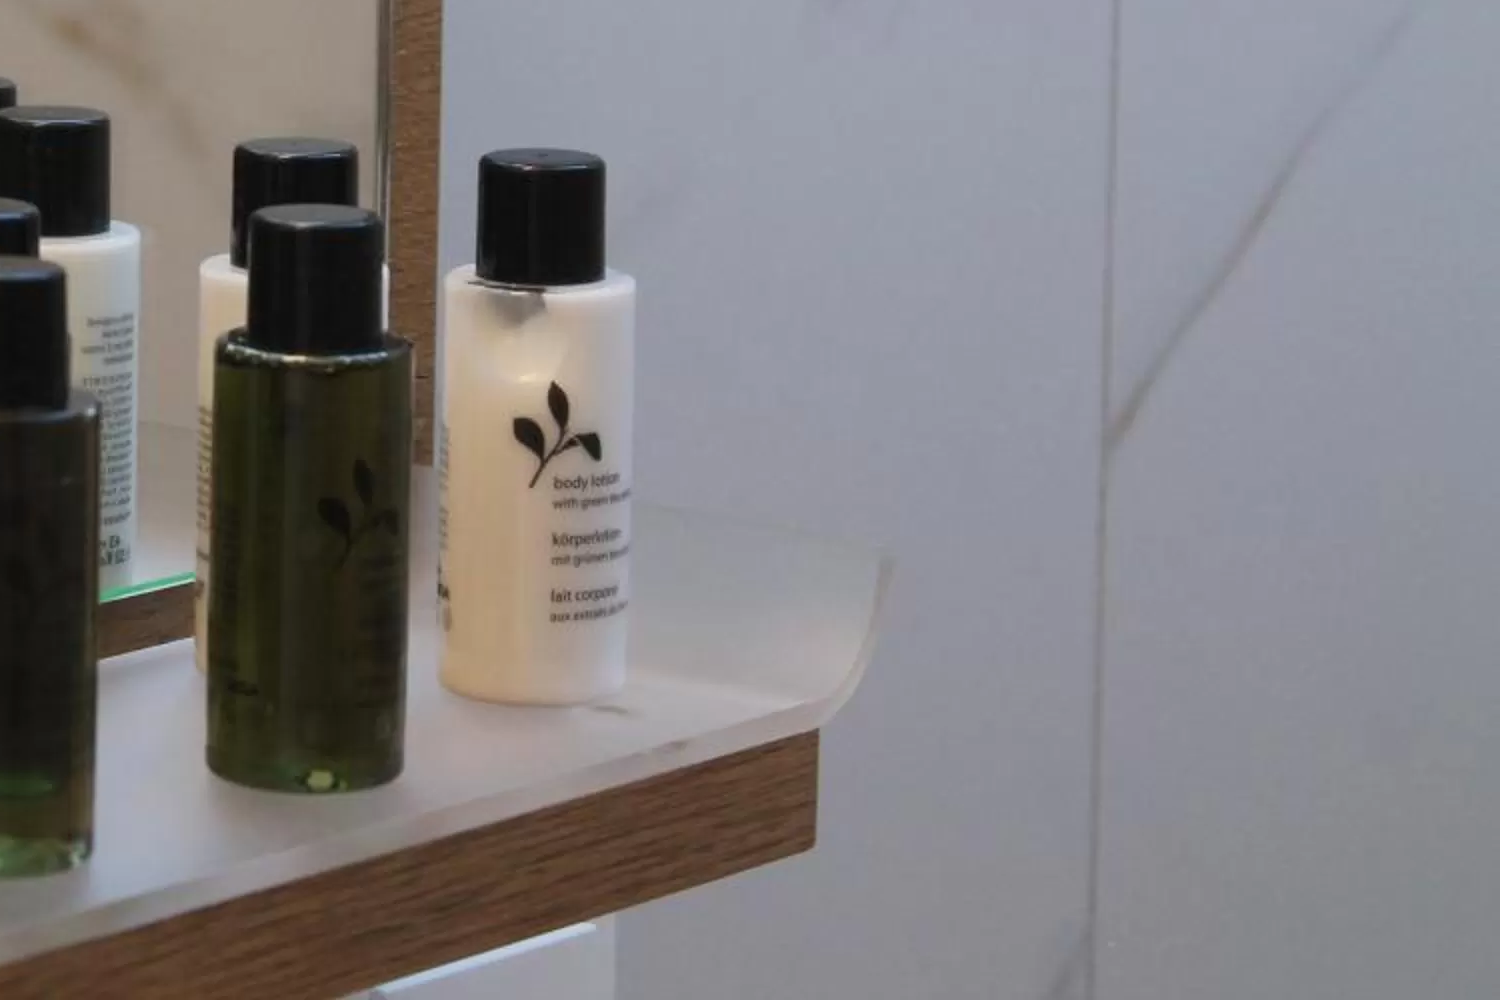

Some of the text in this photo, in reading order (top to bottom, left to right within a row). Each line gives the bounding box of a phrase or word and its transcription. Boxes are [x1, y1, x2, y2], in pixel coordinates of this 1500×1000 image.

[552, 475, 588, 492] body
[552, 497, 579, 510] with
[550, 588, 572, 603] lait
